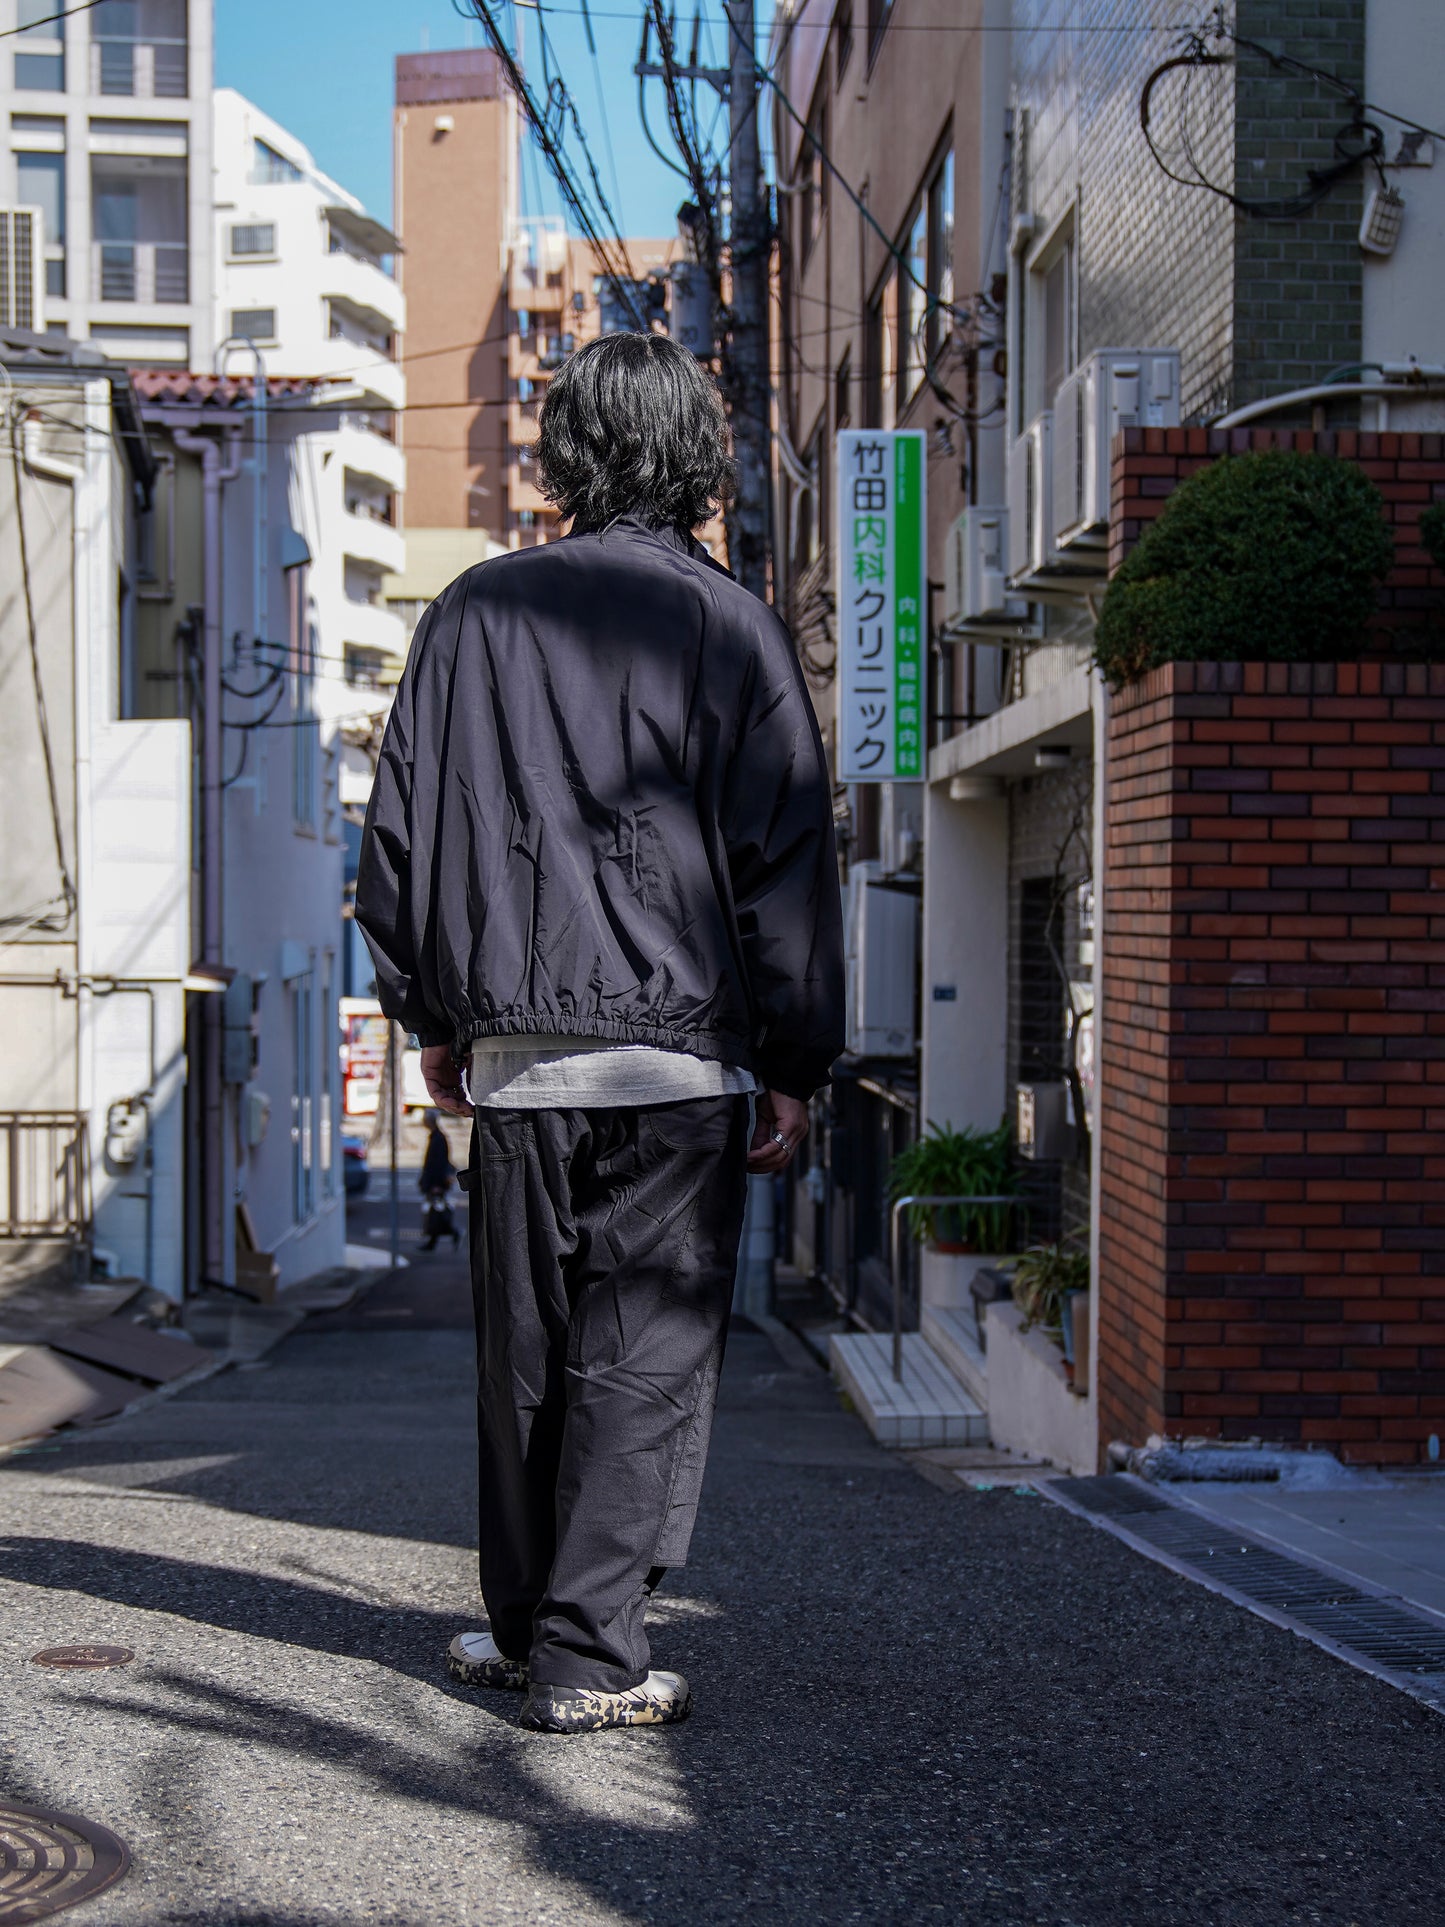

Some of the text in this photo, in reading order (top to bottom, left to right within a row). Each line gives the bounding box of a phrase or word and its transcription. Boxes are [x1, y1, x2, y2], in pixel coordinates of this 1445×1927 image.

[853, 439, 887, 771] 竹田内科クリニック
